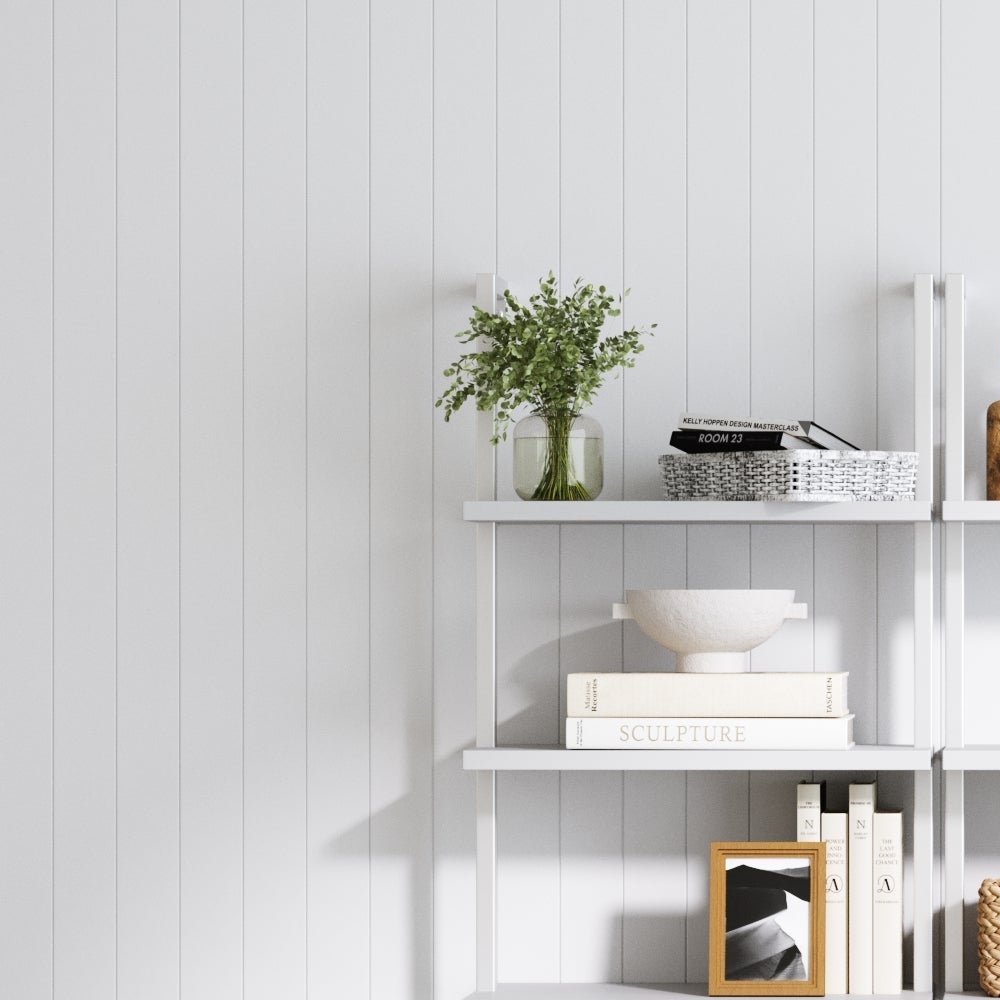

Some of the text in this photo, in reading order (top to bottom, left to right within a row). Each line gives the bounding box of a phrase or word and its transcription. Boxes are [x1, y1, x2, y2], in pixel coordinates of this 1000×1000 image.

[703, 418, 728, 427] HOPPEN
[729, 420, 752, 429] DESIGN
[753, 422, 799, 431] MASTERCLASS
[698, 433, 743, 443] ROOM 23
[619, 725, 746, 742] SCULPTURE
